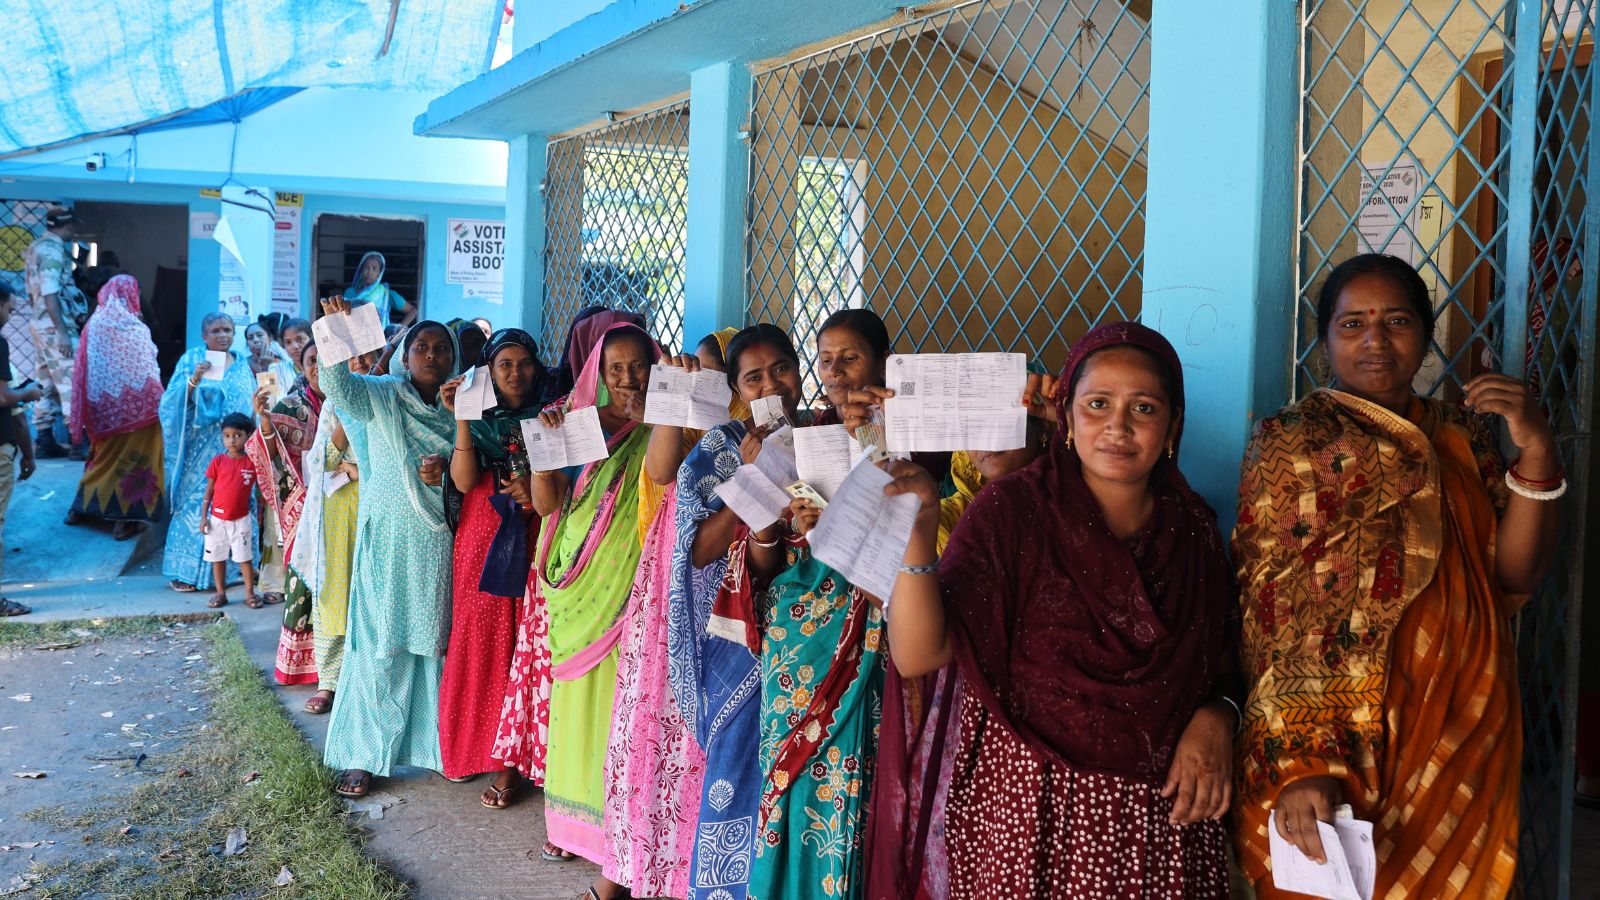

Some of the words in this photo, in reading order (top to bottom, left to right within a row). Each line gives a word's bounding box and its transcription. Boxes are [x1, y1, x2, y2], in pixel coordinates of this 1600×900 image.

[474, 225, 505, 239] VOT
[453, 240, 504, 254] ASSIST
[472, 256, 504, 270] BOO
